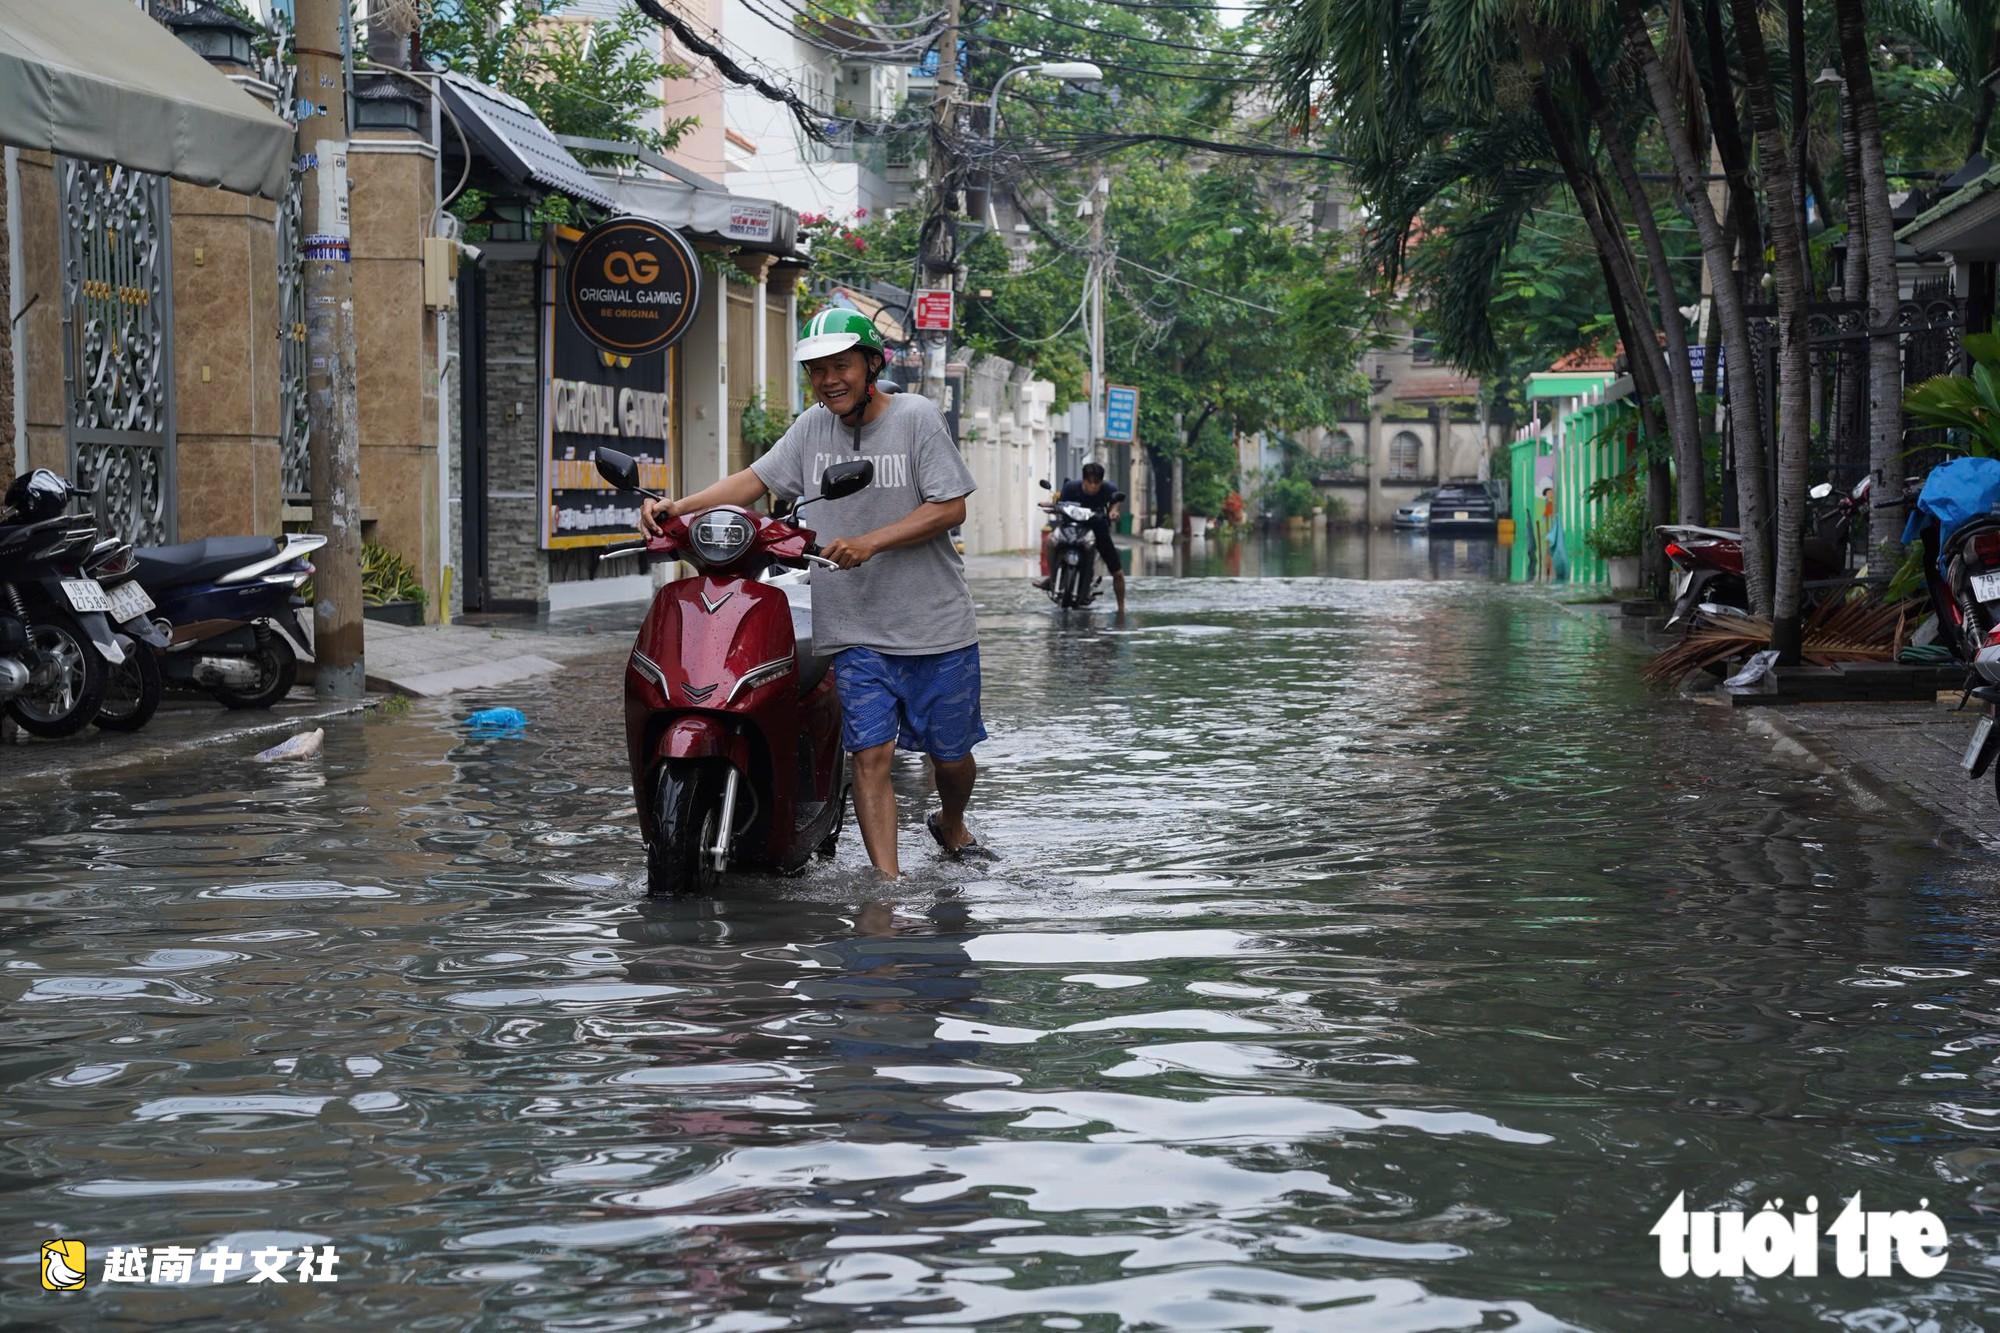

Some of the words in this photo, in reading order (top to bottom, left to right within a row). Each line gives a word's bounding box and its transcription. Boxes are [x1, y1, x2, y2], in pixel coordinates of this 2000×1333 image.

[603, 250, 660, 284] OG
[580, 288, 633, 303] ORIGINAL
[636, 290, 682, 305] GAMING
[600, 309, 613, 318] BE
[615, 310, 659, 320] ORIGINAL
[812, 452, 907, 488] CION
